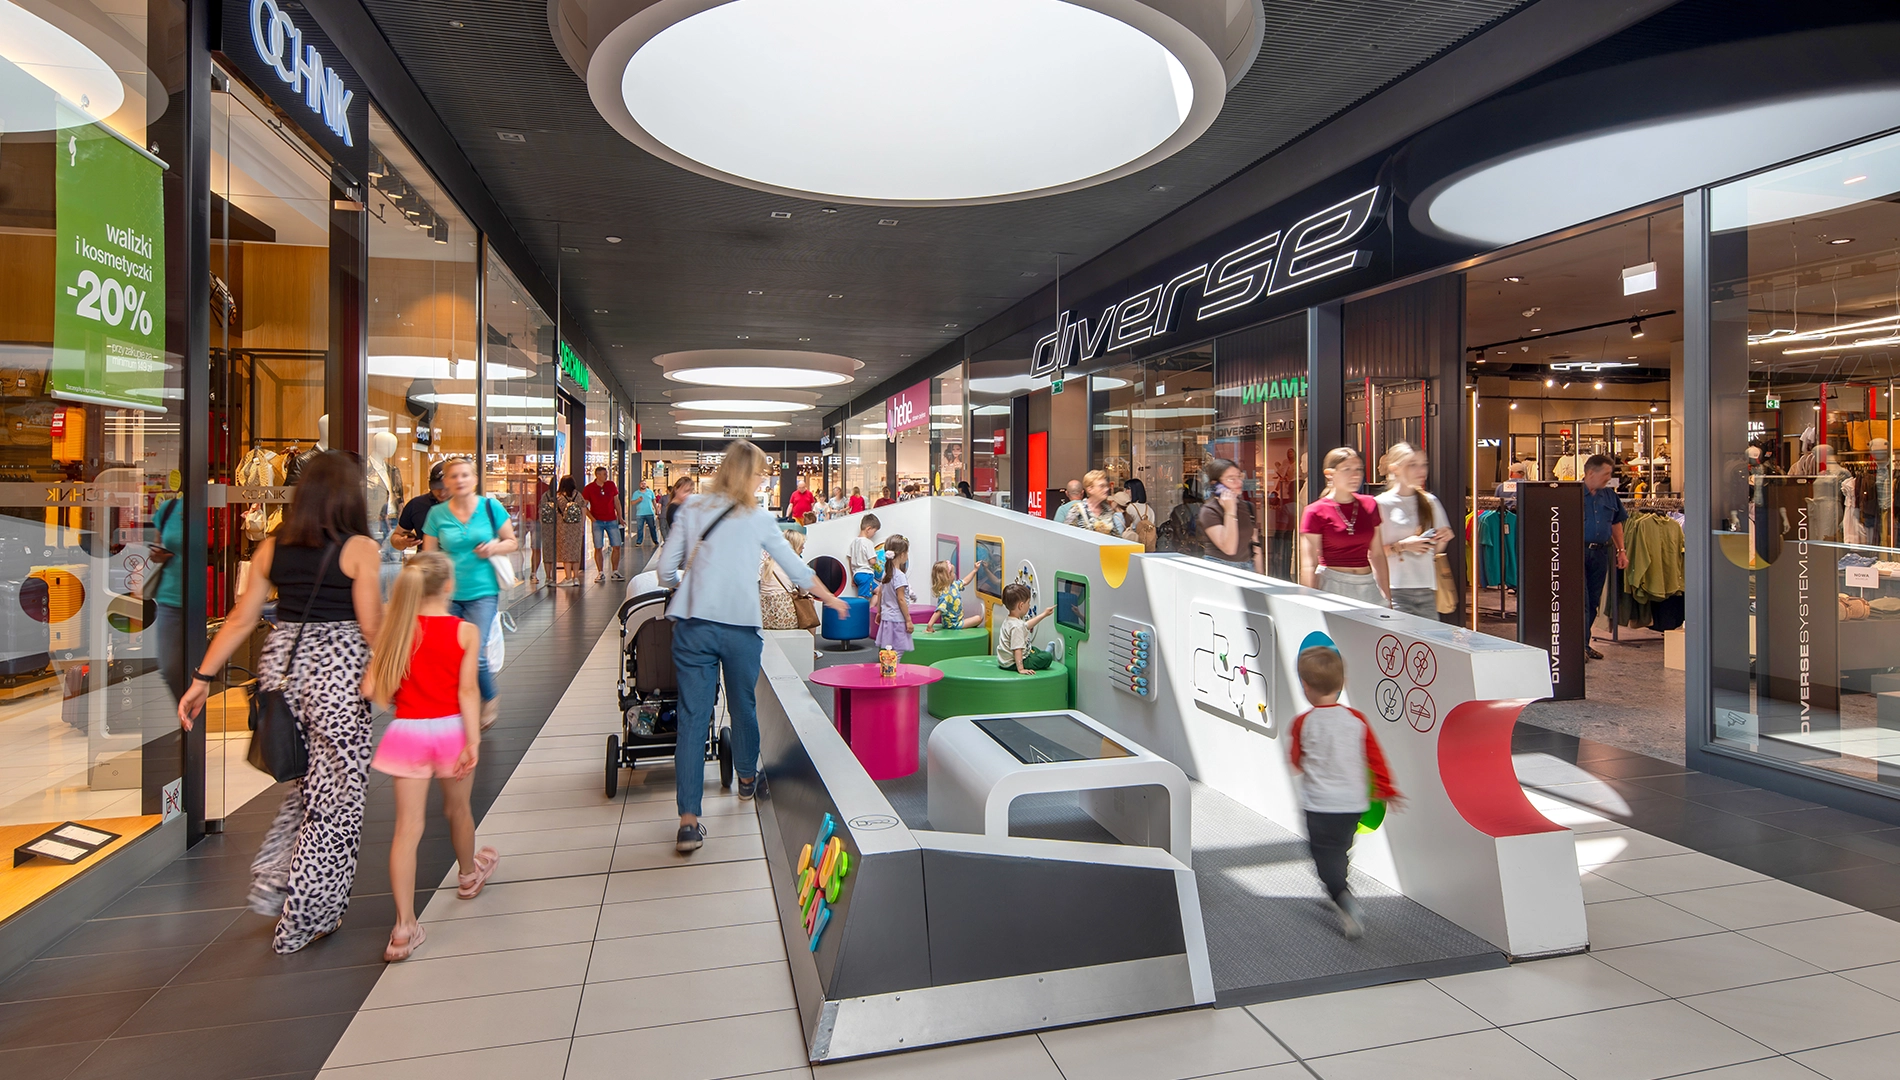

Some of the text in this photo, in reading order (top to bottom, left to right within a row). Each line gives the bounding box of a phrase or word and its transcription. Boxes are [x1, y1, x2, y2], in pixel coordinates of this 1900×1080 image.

[249, 0, 354, 147] OCHNIK
[75, 236, 152, 283] i kosmetyczki
[105, 223, 152, 260] walizki
[66, 269, 153, 336] -20%
[1030, 185, 1381, 379] diverse
[893, 393, 913, 428] hebe
[1028, 491, 1042, 508] ALE
[1550, 506, 1561, 684] DIVERSESYSTEM.COM
[1797, 507, 1811, 736] DIVERSESYSTEM.COM
